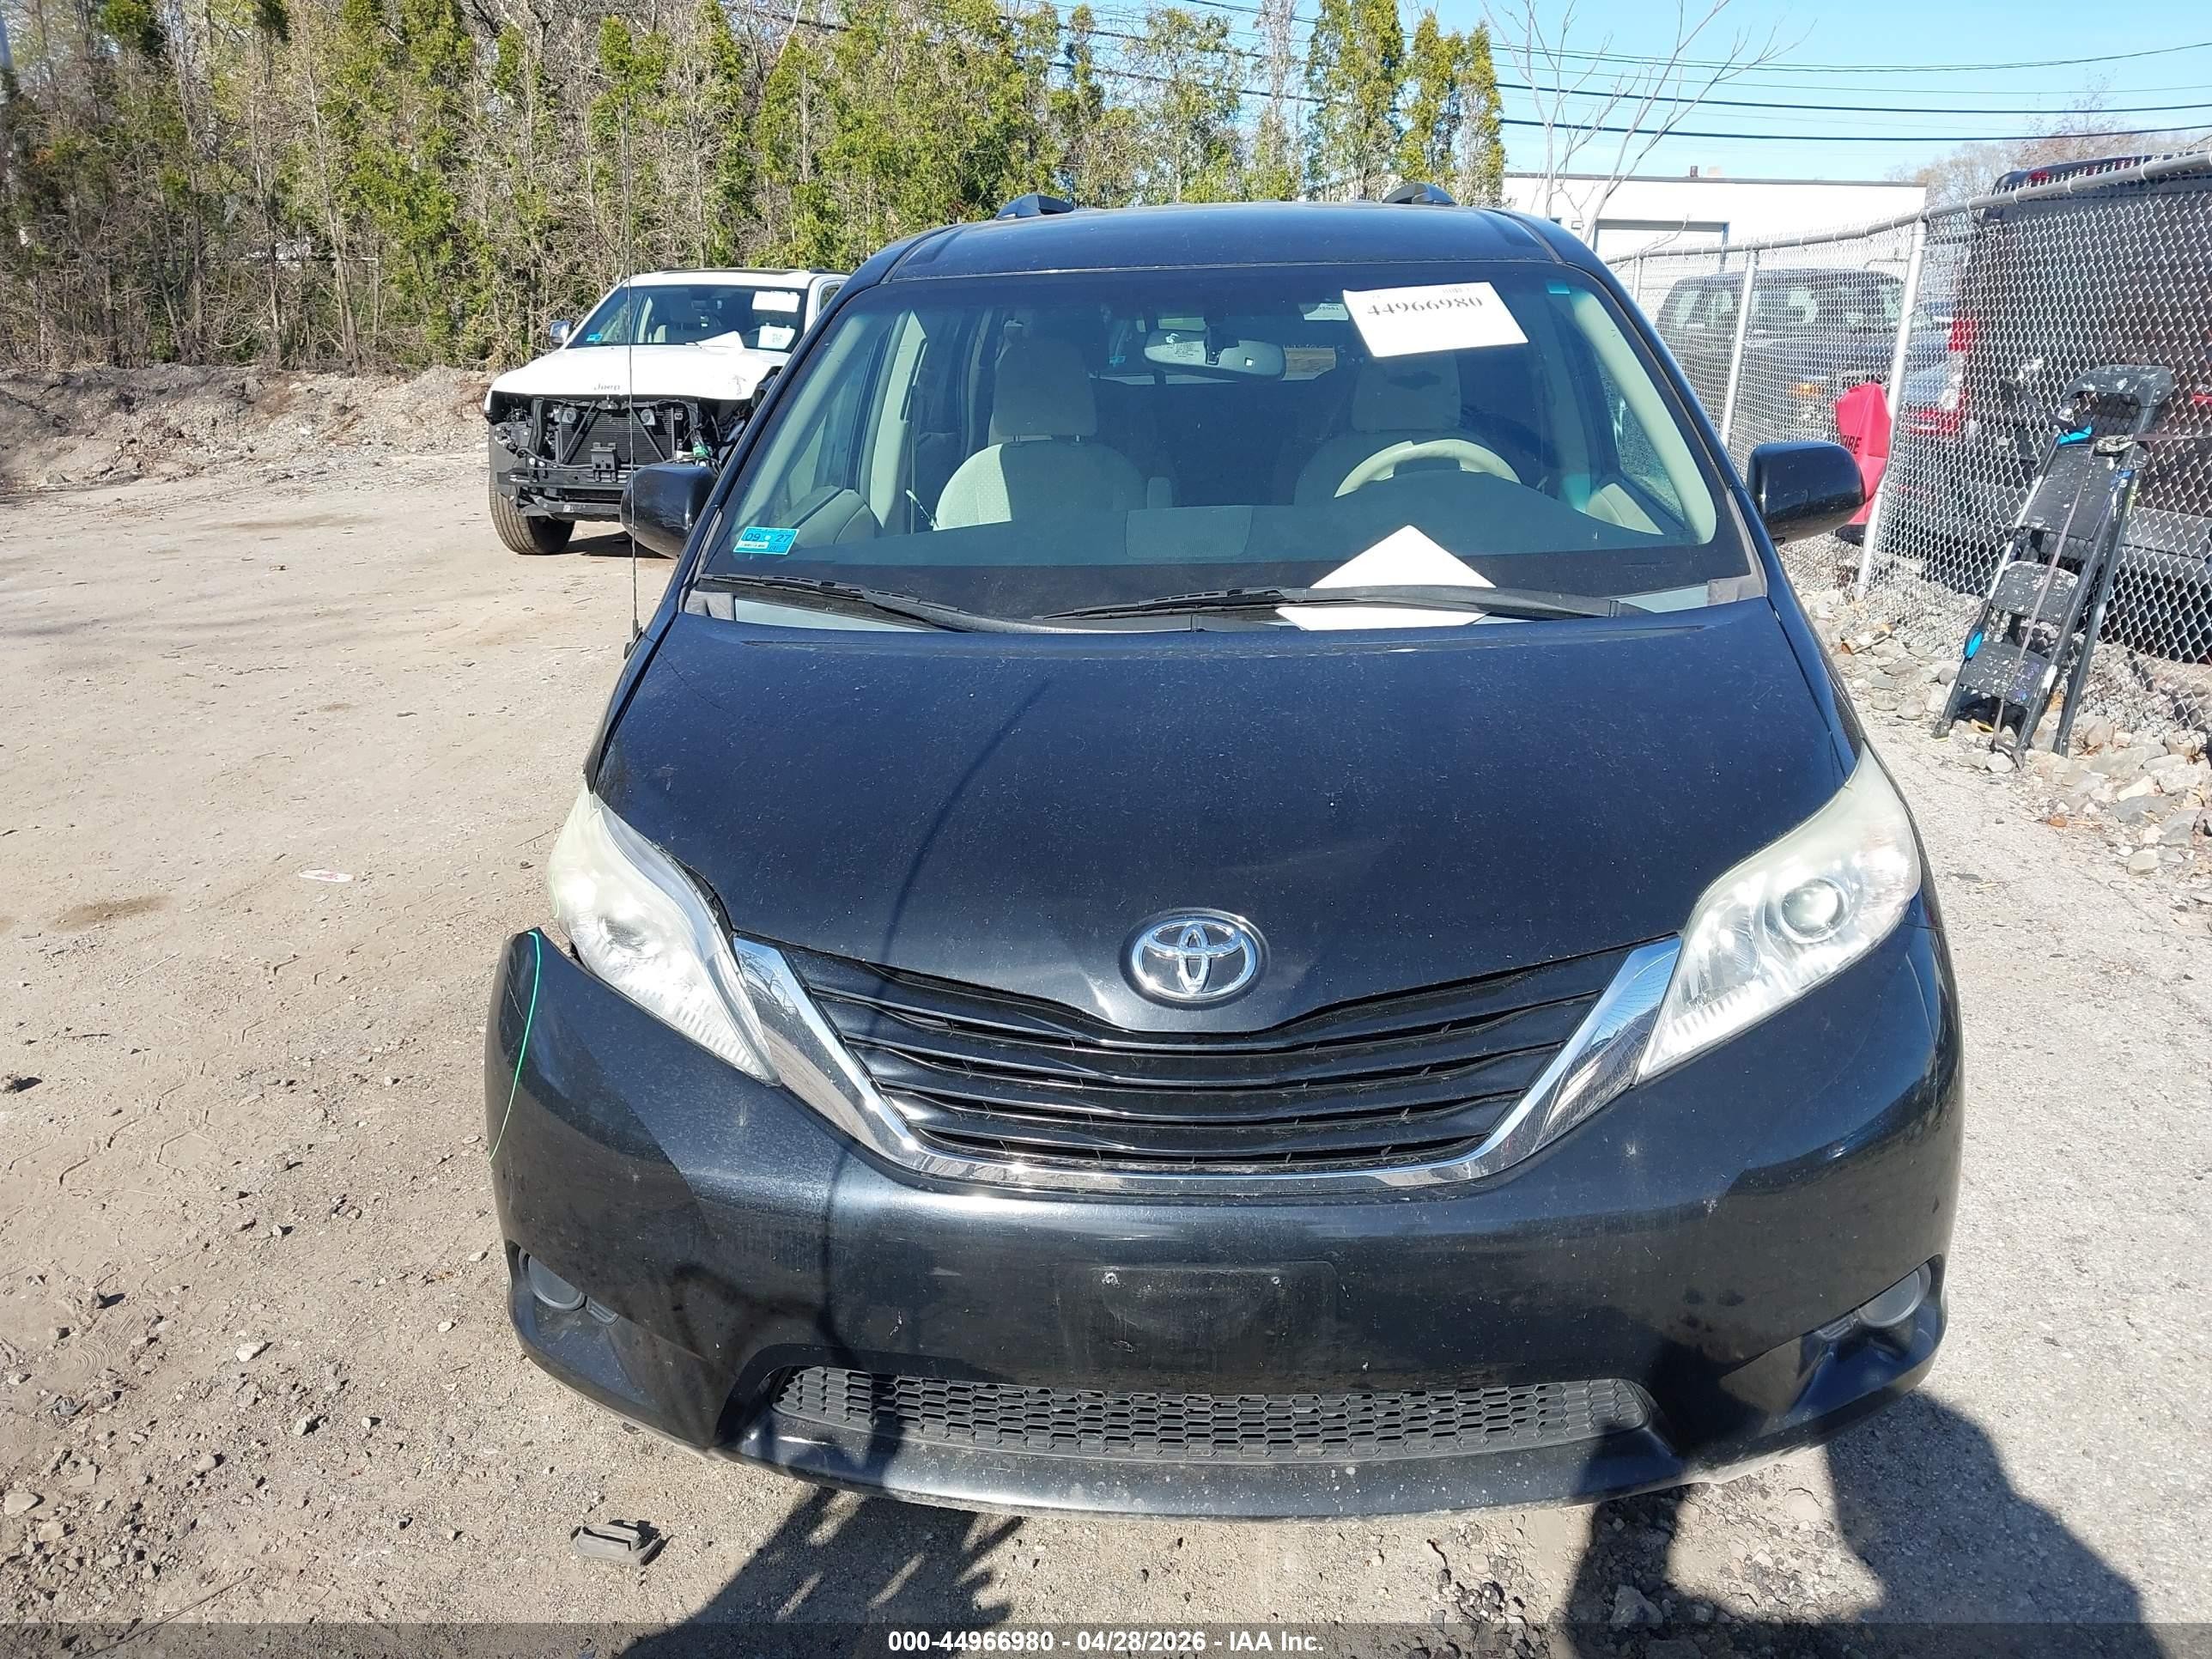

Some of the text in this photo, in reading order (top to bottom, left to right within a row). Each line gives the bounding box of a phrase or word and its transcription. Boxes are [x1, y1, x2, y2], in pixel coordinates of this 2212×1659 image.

[1367, 296, 1483, 316] 44966980
[1844, 434, 1863, 455] IRE
[745, 532, 793, 543] 09 27
